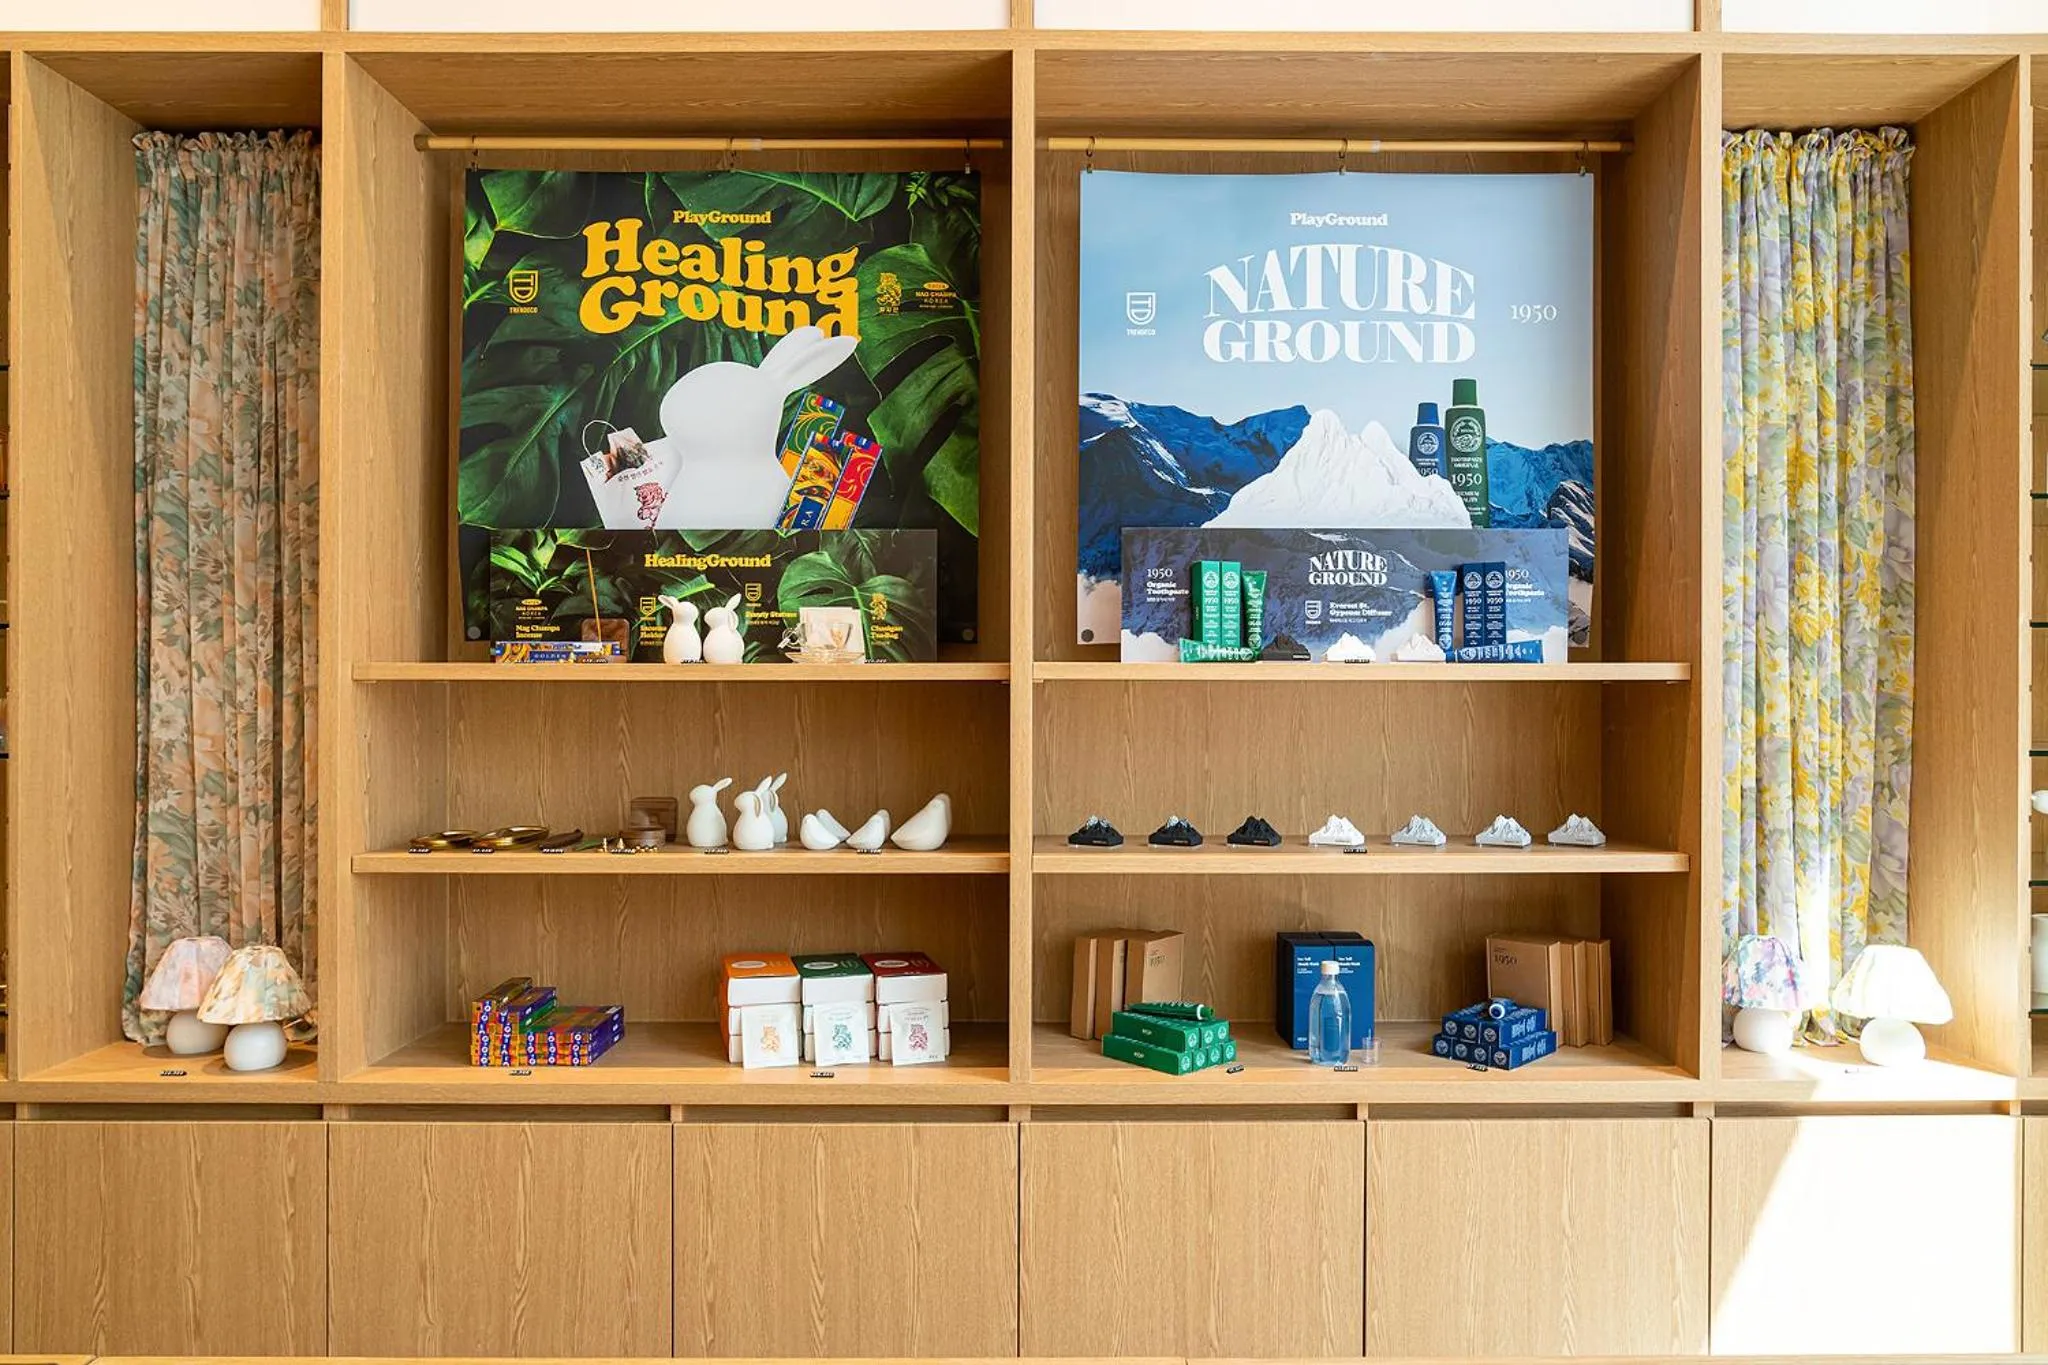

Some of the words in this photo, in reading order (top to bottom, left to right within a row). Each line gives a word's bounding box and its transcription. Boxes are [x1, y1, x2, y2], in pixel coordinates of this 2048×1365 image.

[673, 209, 772, 226] PlayGround
[1290, 212, 1388, 228] PlayGround
[581, 217, 859, 305] Healing
[1203, 243, 1476, 319] NATURE
[579, 275, 862, 343] Ground
[1510, 303, 1558, 323] 1950
[1202, 319, 1476, 363] GROUND
[1451, 472, 1482, 487] 1950
[644, 553, 772, 571] HealingGround
[1308, 549, 1388, 573] NATURE
[1146, 567, 1173, 579] 1950
[1308, 571, 1388, 586] GROUND
